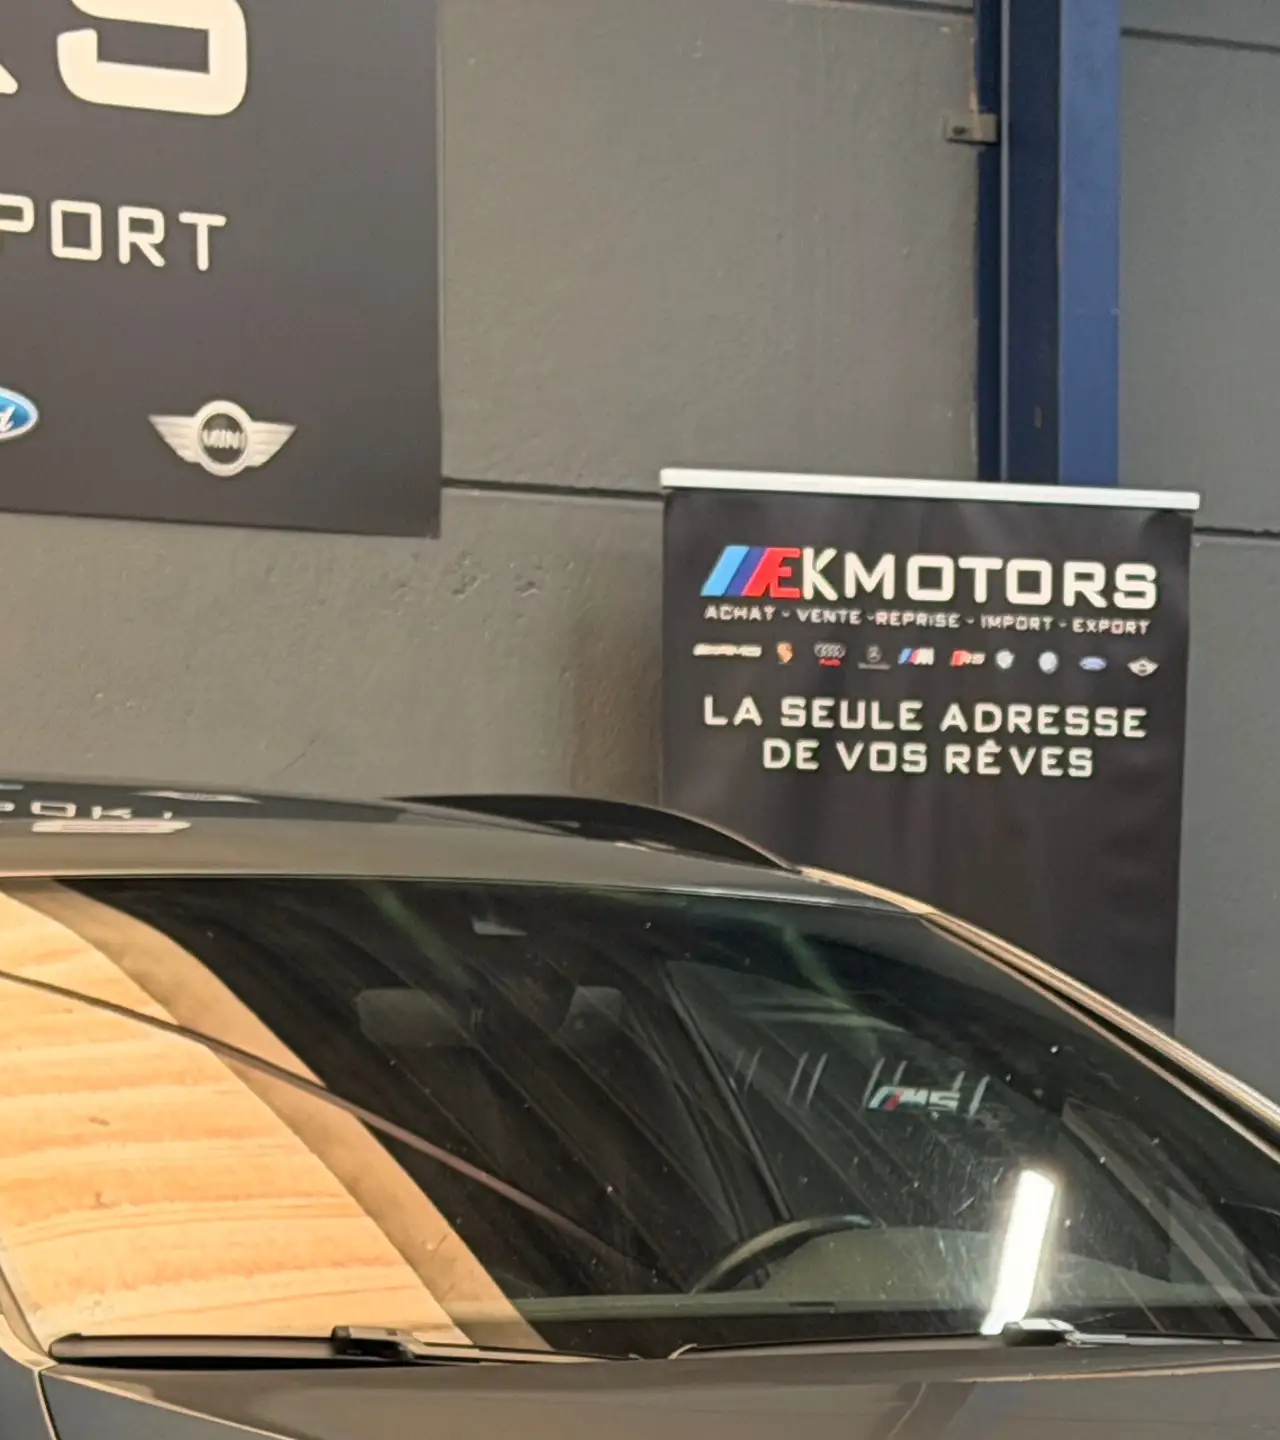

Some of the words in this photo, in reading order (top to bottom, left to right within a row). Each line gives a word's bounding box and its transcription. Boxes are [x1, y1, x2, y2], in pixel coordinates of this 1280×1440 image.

[704, 604, 776, 622] ACHAT
[796, 608, 862, 626] VENTE
[980, 613, 1054, 632] IMPORT
[1072, 618, 1151, 636] EXPORT
[703, 695, 763, 727] LA
[780, 696, 923, 731] SEULE
[940, 702, 1148, 739] ADRESSE
[762, 738, 820, 770] DE
[835, 741, 928, 774] VOS
[945, 739, 1094, 777] RÊVES
